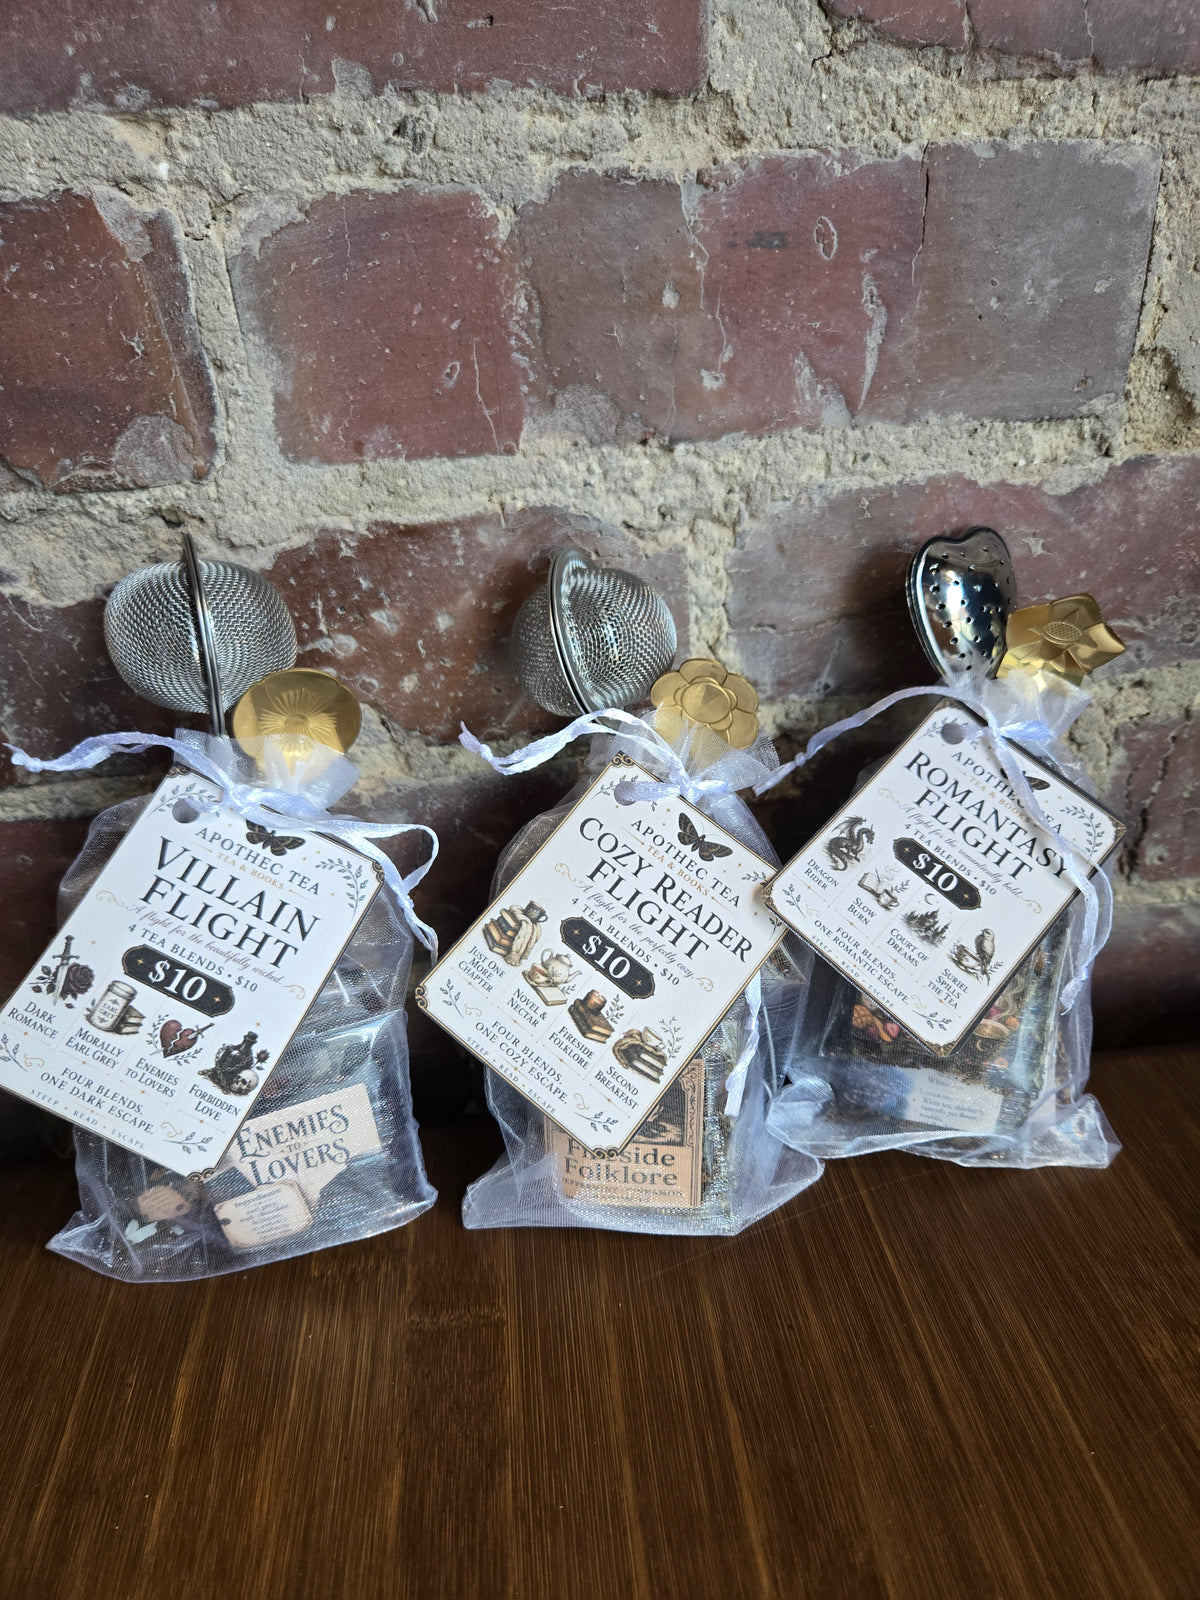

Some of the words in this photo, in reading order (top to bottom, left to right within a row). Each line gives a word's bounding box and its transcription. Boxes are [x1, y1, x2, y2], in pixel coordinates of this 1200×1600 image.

[902, 750, 1067, 880] ROMANTASY
[968, 776, 986, 792] TEA
[998, 798, 1033, 826] BOOKS
[906, 811, 933, 830] flight
[926, 827, 944, 839] for
[943, 837, 957, 848] the
[957, 847, 1003, 884] romantically
[912, 786, 1033, 881] FLIGHT
[194, 826, 284, 876] APOTHEC
[287, 869, 320, 896] TEA
[216, 851, 237, 867] TEA
[249, 867, 286, 890] BOOKS
[629, 818, 708, 881] APOTHEC
[709, 876, 740, 908] TEA
[646, 844, 665, 863] TEA
[676, 867, 710, 896] BOOKS
[803, 866, 828, 891] RIDER
[806, 857, 840, 888] DRAGON
[903, 822, 912, 830] 4
[912, 827, 932, 847] TEA
[932, 844, 972, 877] BLENDS
[977, 879, 997, 896] $10
[911, 852, 958, 892] $10
[156, 834, 321, 942] VILLAIN
[578, 816, 654, 879] COZY
[649, 870, 753, 964] READER
[584, 856, 710, 960] FLIGHT
[851, 896, 877, 918] SLOW
[137, 873, 299, 969] FLIGHT
[585, 891, 616, 912] flight
[609, 910, 628, 924] for
[627, 922, 643, 936] the
[638, 935, 678, 965] perfectly
[846, 902, 870, 926] BURN
[127, 923, 137, 933] 4
[139, 926, 166, 948] TEA
[169, 942, 225, 976] BLENDS
[233, 974, 258, 993] $10
[139, 909, 174, 929] flight
[166, 923, 187, 937] for
[186, 932, 204, 945] the
[203, 939, 252, 972] beautifully
[570, 896, 579, 905] 4
[581, 903, 604, 926] TEA
[605, 923, 652, 963] BLENDS
[658, 967, 680, 986] $10
[580, 934, 631, 979] $10
[834, 925, 861, 950] FOUR
[860, 947, 896, 982] BLENDS.
[885, 936, 919, 967] DREAMS
[889, 927, 918, 953] COURT
[916, 950, 930, 962] OF
[147, 958, 208, 1002] $10
[457, 959, 494, 993] CHAPTER
[466, 944, 489, 964] JUST
[486, 959, 505, 979] ONE
[467, 956, 494, 981] MORE
[813, 918, 834, 938] ONE
[831, 934, 878, 976] ROMANTIC
[875, 973, 909, 1006] ESCAPE.
[940, 967, 969, 994] SURIEL
[511, 986, 540, 1015] NOVEL
[538, 1010, 548, 1021] &
[926, 979, 944, 996] THE
[942, 991, 958, 1010] TEA
[934, 974, 962, 1000] SPILLS
[6, 1006, 59, 1040] ROMANCE
[23, 1000, 57, 1025] DARK
[505, 996, 540, 1028] NECTAR
[64, 1035, 91, 1057] EARL
[90, 1048, 120, 1069] GREY
[70, 1026, 124, 1058] MORALLY
[490, 1019, 521, 1048] FOUR
[520, 1044, 563, 1085] BLENDS.
[547, 1030, 590, 1070] FOLKLORE
[557, 1024, 595, 1060] FIRESIDE
[124, 1066, 139, 1079] TO
[136, 1071, 176, 1098] LOVERS
[134, 1056, 180, 1086] ENEMIES
[474, 1021, 499, 1044] ONE
[498, 1041, 529, 1068] COZY
[526, 1065, 568, 1105] ESCAPE.
[604, 1065, 639, 1096] SECOND
[39, 1071, 68, 1091] ONE
[68, 1085, 106, 1110] DARK
[106, 1104, 154, 1135] ESCAPE.
[59, 1066, 94, 1090] FOUR
[94, 1083, 144, 1116] BLENDS.
[187, 1082, 241, 1117] FORBIDDEN
[593, 1069, 639, 1110] BREAKFAST
[193, 1099, 222, 1122] LOVE
[236, 1103, 350, 1162] ENEMIES
[249, 1138, 351, 1186] LOVERS
[564, 1156, 678, 1187] Folklore
